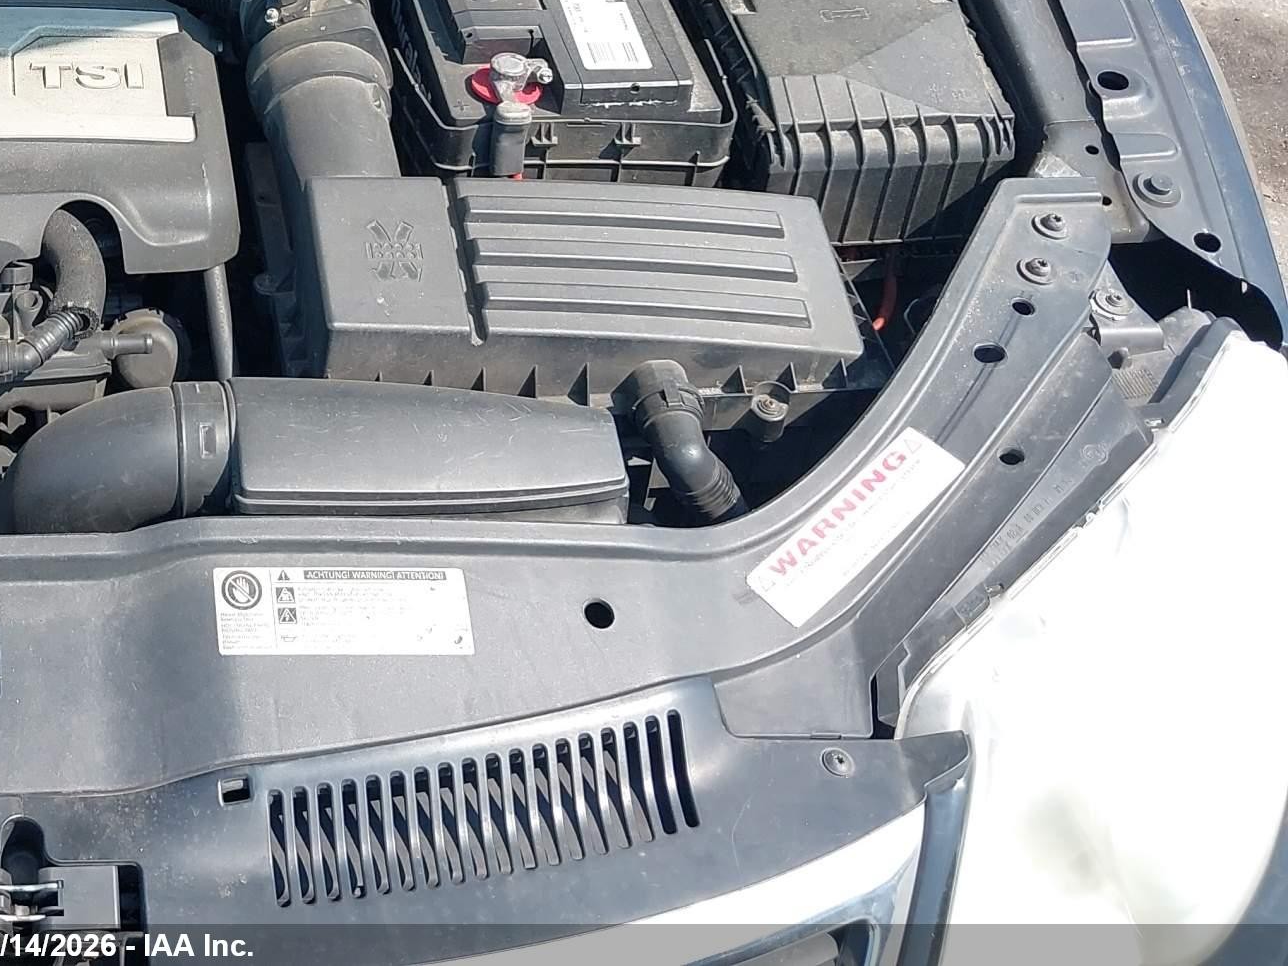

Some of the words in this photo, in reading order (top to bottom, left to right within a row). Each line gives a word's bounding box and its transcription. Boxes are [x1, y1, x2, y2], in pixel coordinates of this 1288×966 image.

[29, 62, 144, 89] TSI
[769, 451, 906, 576] WARNING
[306, 570, 350, 579] ACHTUNG!
[352, 570, 394, 579] WARNING!
[397, 570, 443, 580] ATTENTION!
